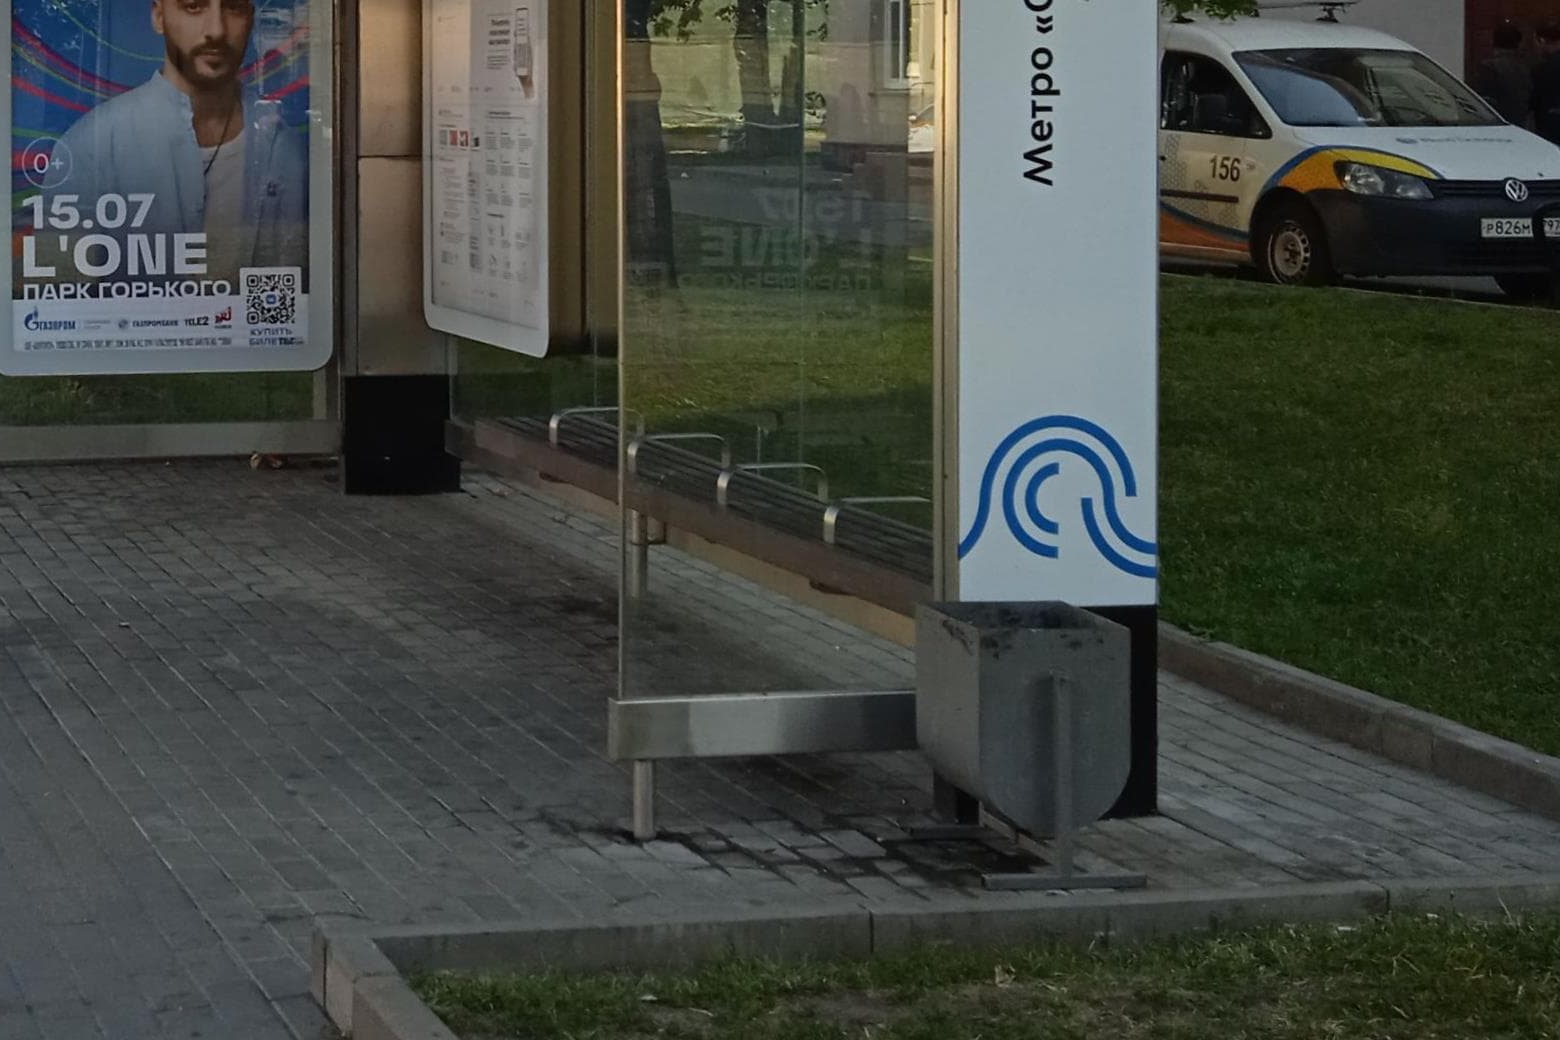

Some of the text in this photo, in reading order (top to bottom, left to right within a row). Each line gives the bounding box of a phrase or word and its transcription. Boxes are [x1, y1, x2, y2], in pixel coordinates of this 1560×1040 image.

[1022, 46, 1061, 187] Метро
[34, 153, 64, 174] 0+
[1209, 156, 1241, 181] 156
[21, 193, 155, 230] 15.07
[23, 233, 207, 278] L'ONE
[23, 279, 232, 301] ПАРК ГОРЬКОГО
[184, 316, 209, 327] TELE2
